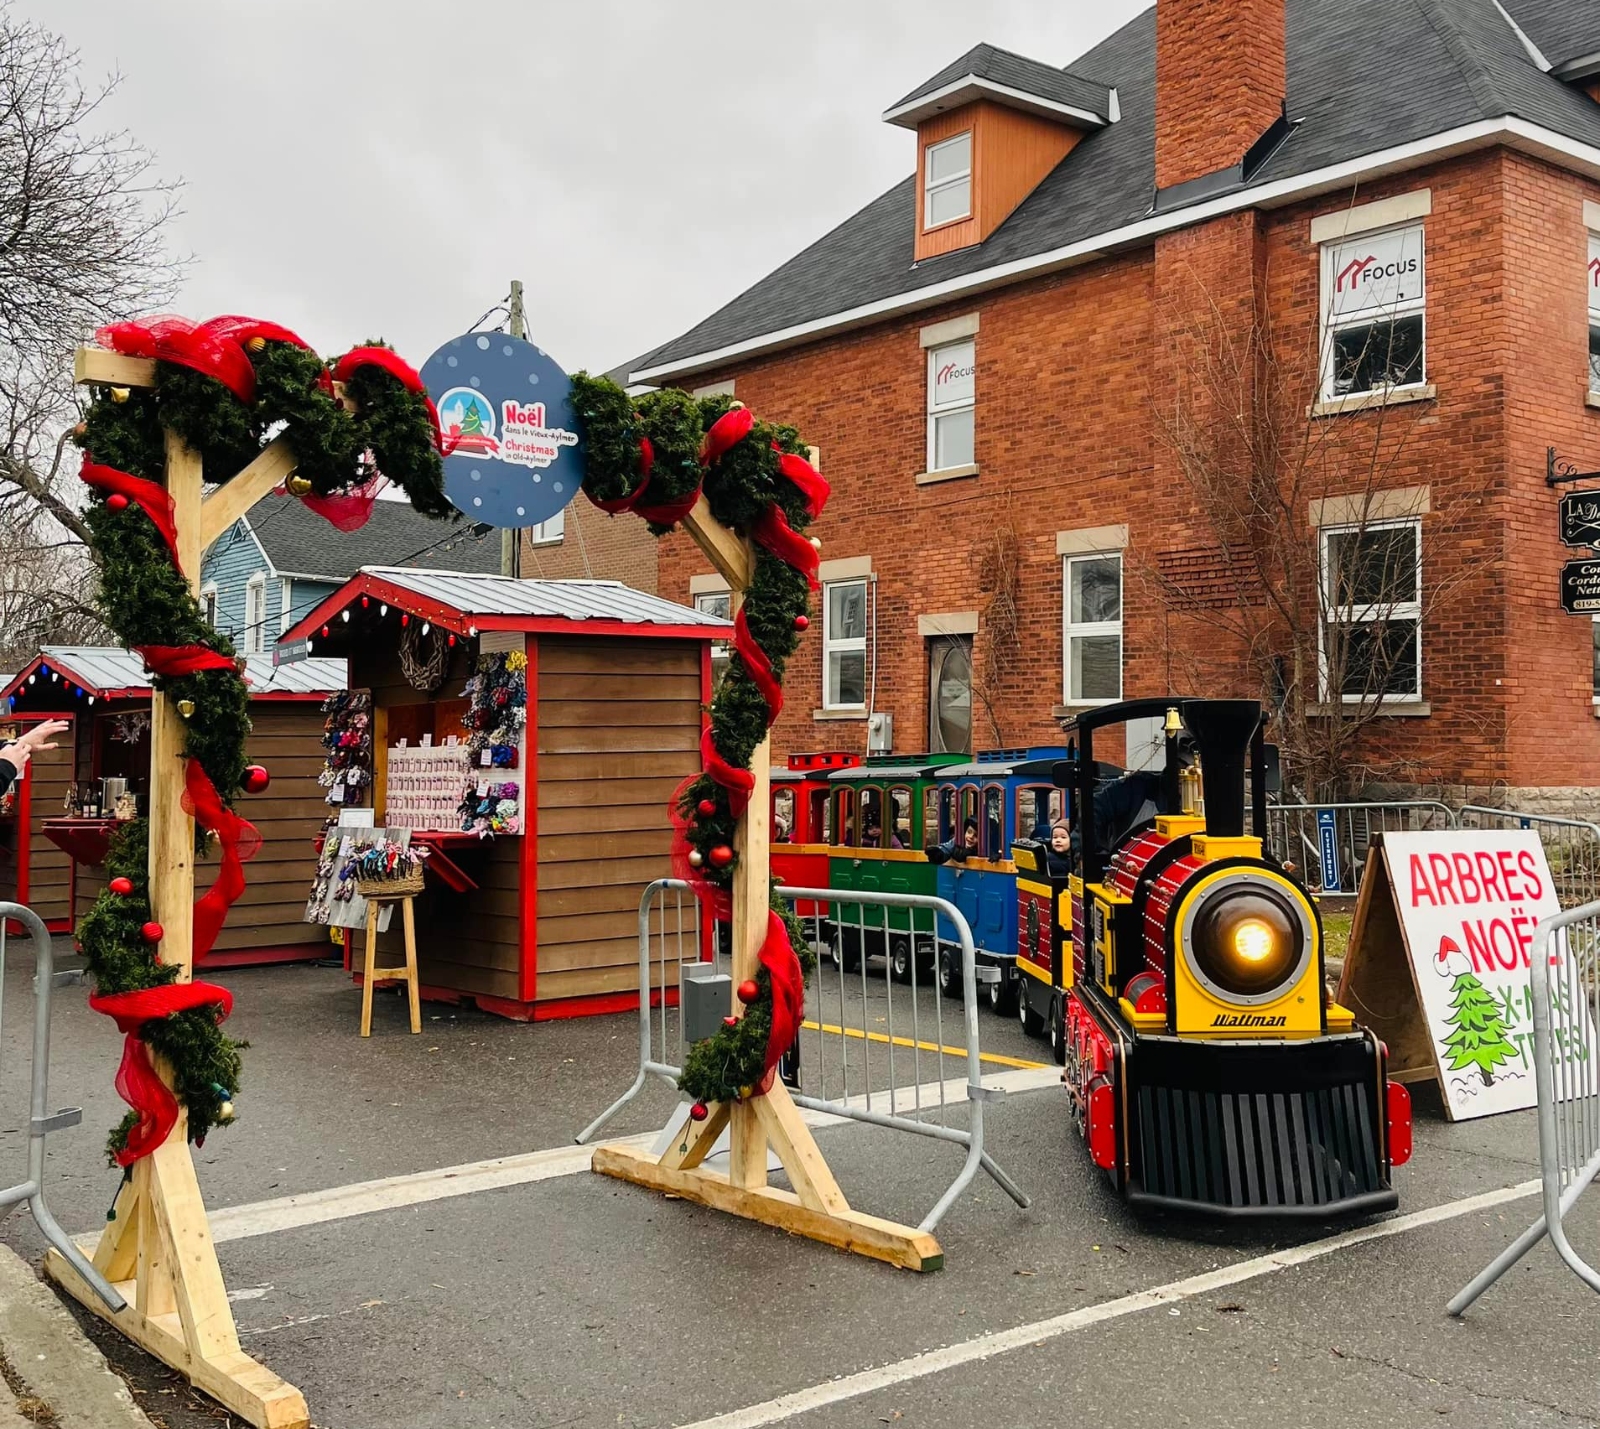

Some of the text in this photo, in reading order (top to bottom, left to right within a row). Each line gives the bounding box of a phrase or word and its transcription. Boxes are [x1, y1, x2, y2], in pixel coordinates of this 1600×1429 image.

[1363, 258, 1417, 283] FOCUS
[949, 365, 976, 380] FOCUS
[505, 404, 542, 428] Noël
[505, 425, 575, 442] dans le Vieux-Aylmer
[505, 439, 555, 456] Christmas
[512, 453, 547, 464] Old-Aylmer
[1409, 850, 1543, 908] ARBRES
[1210, 1013, 1287, 1027] Wattman
